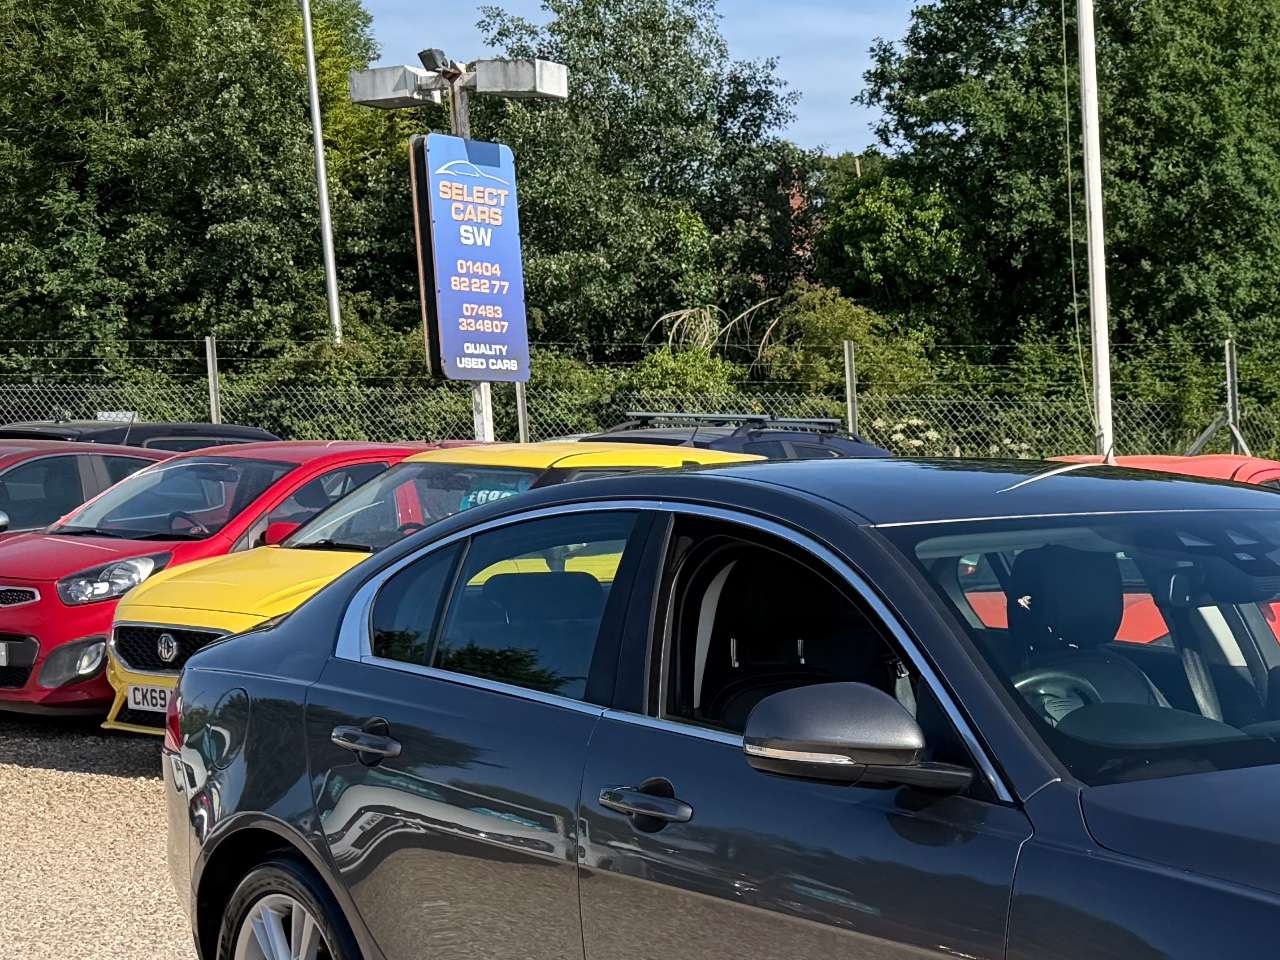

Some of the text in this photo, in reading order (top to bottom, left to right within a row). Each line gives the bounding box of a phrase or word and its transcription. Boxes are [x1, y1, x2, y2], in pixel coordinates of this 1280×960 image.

[439, 181, 509, 207] SELECT
[451, 202, 503, 226] CARS
[459, 224, 493, 247] SW
[456, 259, 502, 277] 01404
[458, 318, 509, 333] 334807
[463, 342, 508, 356] QUALITY
[456, 356, 518, 371] USED CARS
[132, 687, 167, 708] CK69
